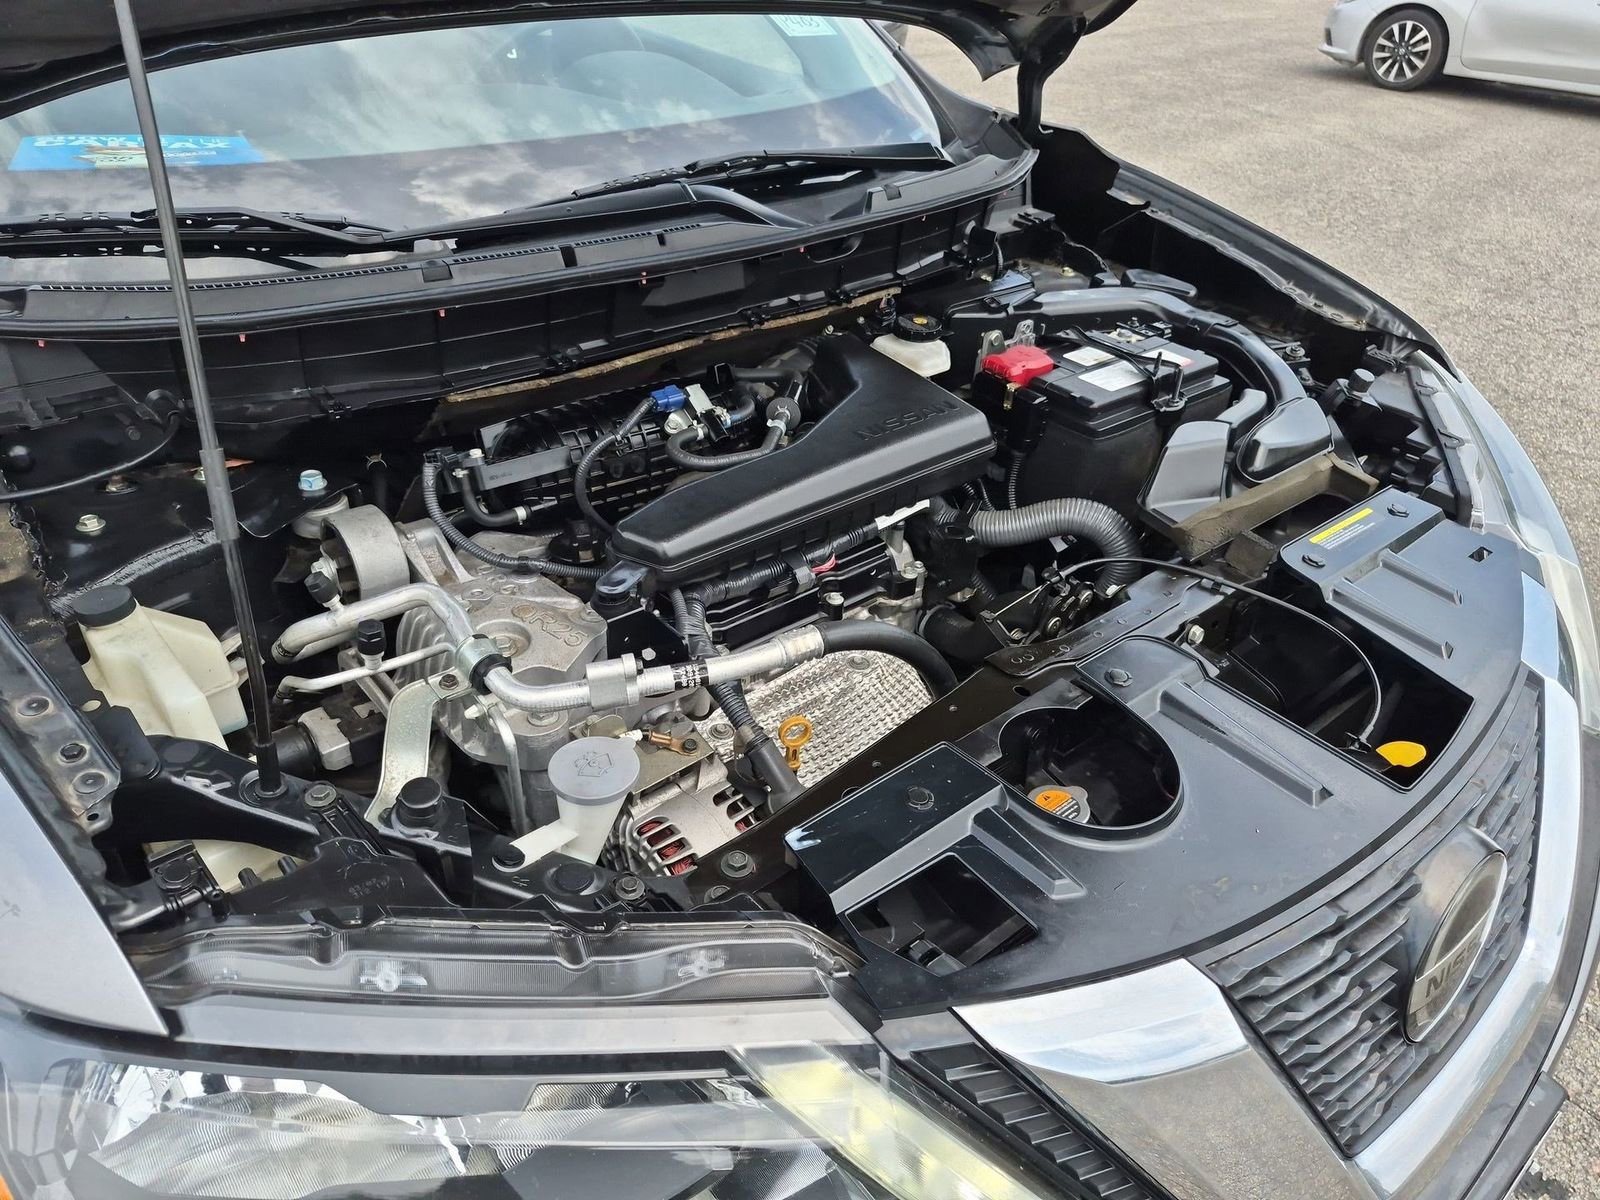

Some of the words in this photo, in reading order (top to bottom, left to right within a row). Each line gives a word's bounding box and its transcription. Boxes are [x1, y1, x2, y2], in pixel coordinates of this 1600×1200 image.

[33, 138, 231, 149] CARAX
[854, 401, 960, 441] NISSAN
[511, 604, 589, 646] QR25
